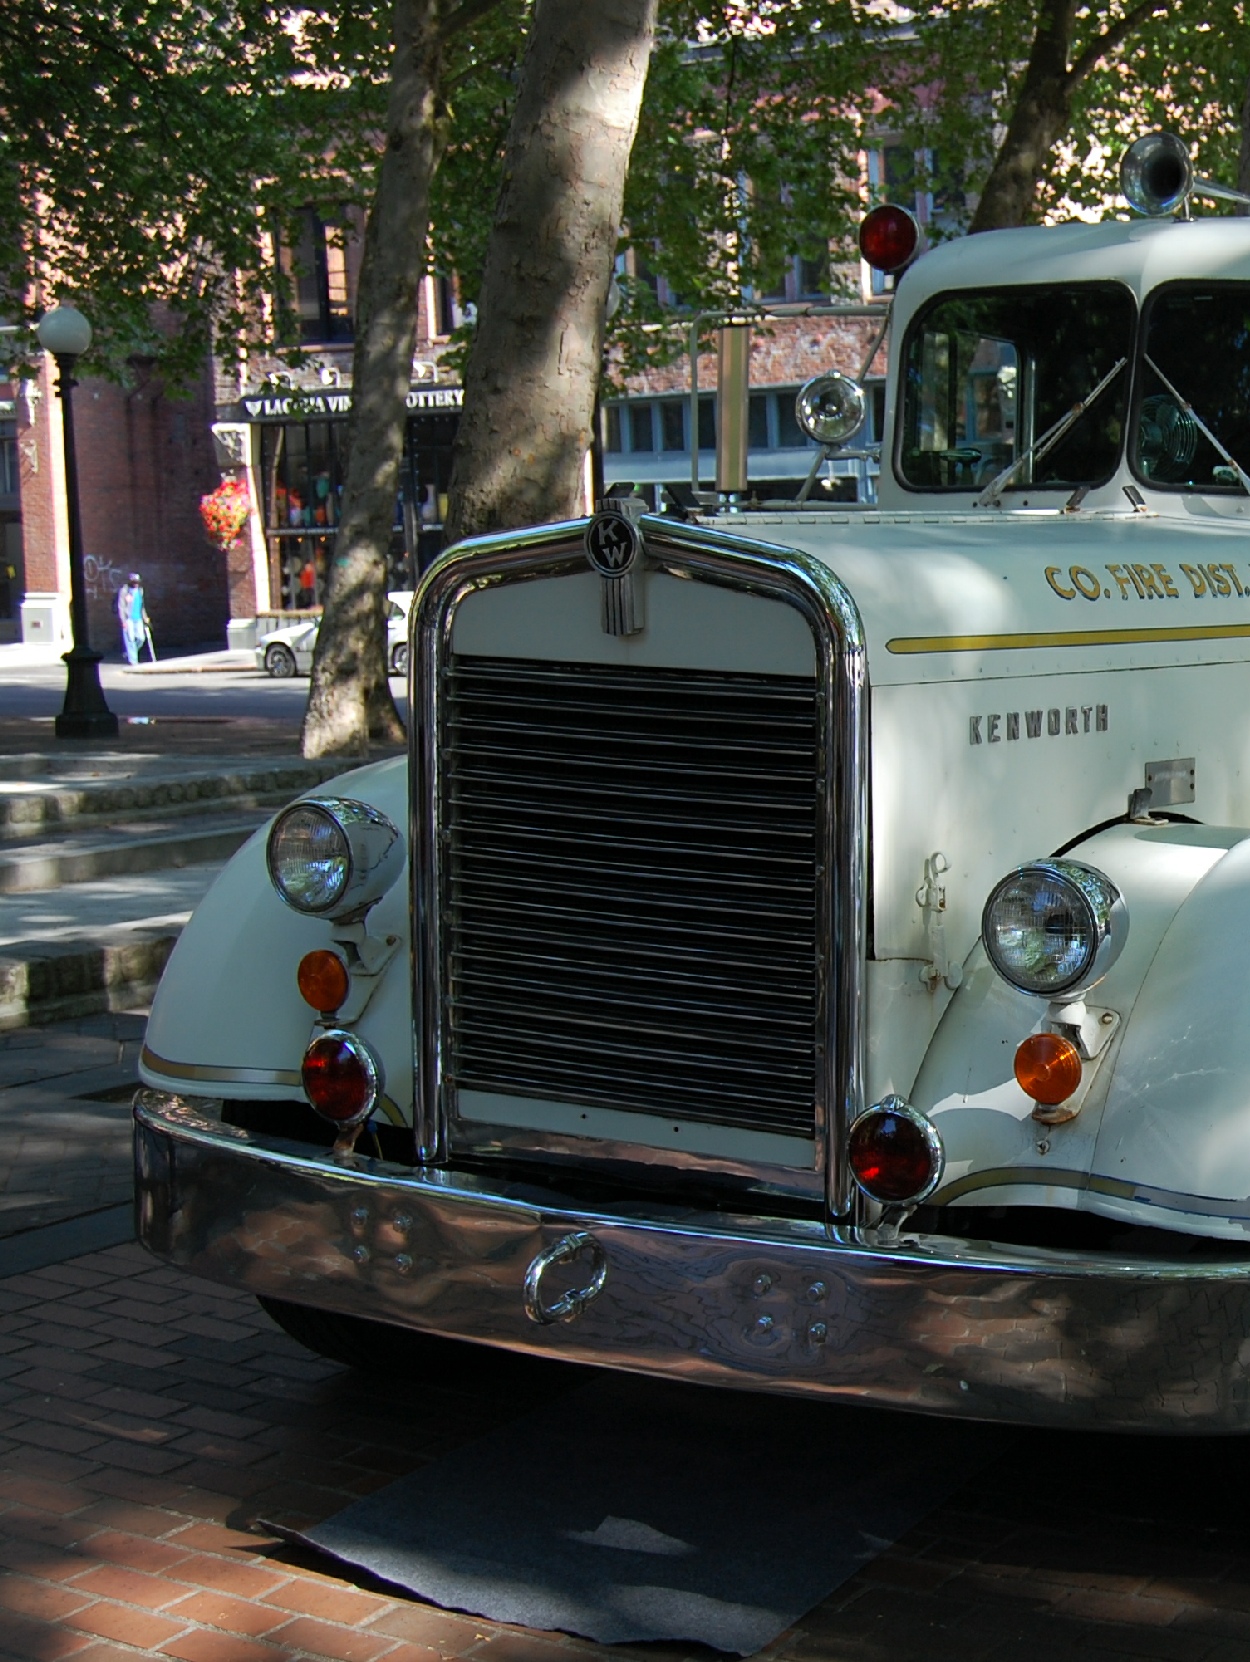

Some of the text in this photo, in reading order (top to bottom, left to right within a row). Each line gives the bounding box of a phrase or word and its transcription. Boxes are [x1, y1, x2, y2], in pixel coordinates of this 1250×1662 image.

[406, 389, 464, 408] OTTERY
[1044, 564, 1111, 602] CO.
[1105, 563, 1180, 601] FIRE
[1178, 563, 1250, 599] DIST.
[969, 703, 1109, 746] KENWORTH
